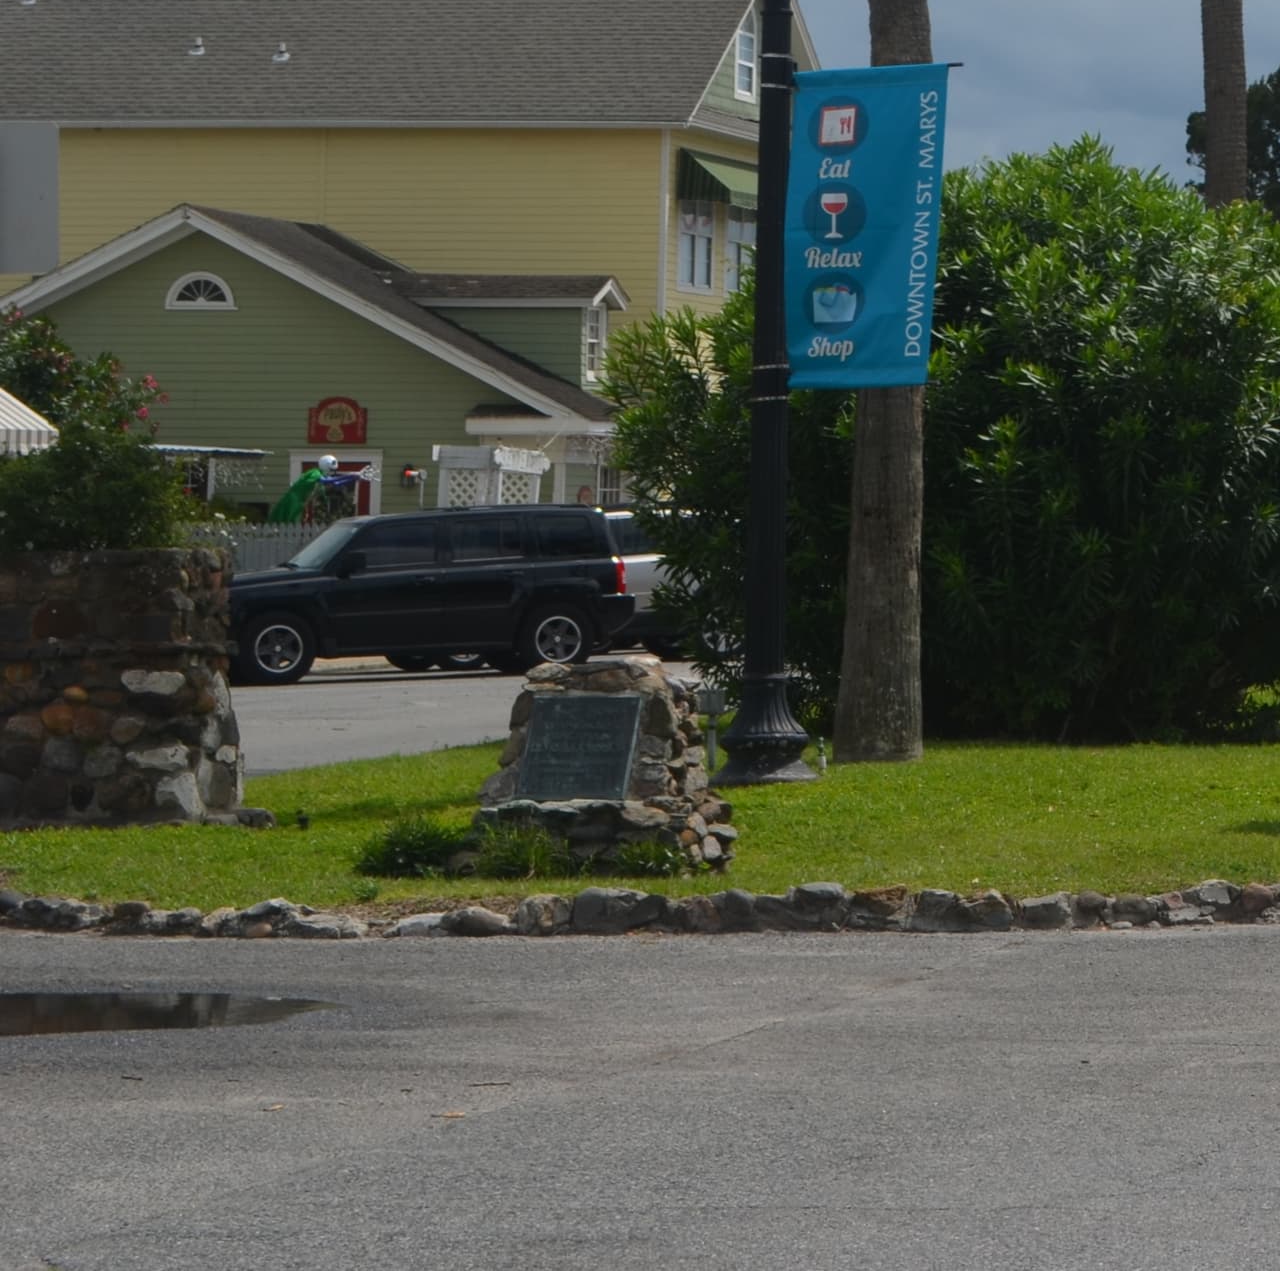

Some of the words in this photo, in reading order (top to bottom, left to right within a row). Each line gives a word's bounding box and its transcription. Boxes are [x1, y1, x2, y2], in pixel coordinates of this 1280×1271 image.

[919, 89, 938, 169] MARYS
[818, 158, 852, 179] Eat
[916, 176, 934, 205] ST.
[804, 246, 863, 269] Relax
[904, 211, 930, 357] DOWNTOWN
[807, 336, 854, 362] Shop
